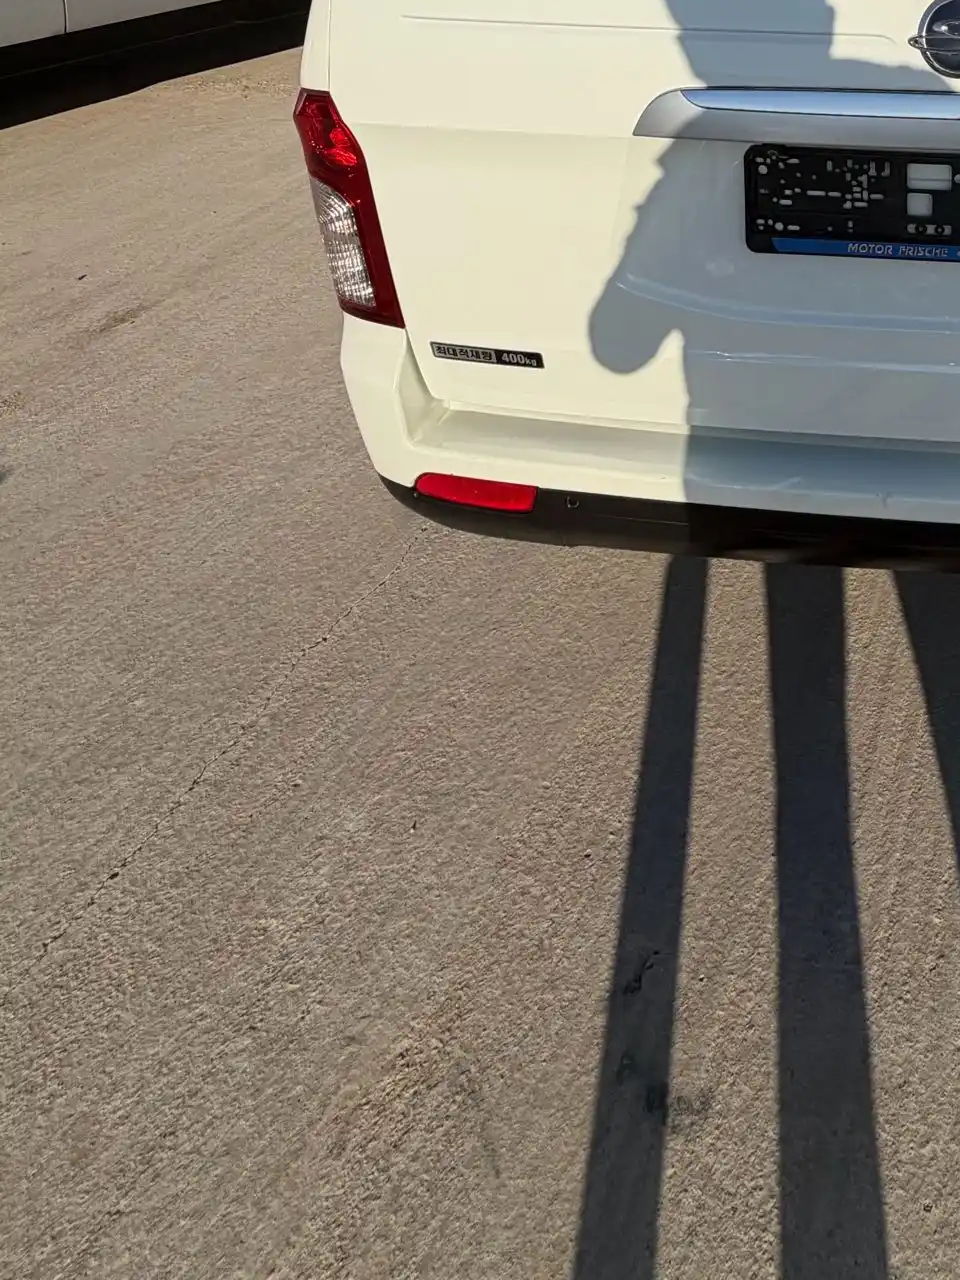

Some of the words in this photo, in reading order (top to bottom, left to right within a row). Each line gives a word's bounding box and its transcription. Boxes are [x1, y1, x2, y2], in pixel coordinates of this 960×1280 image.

[848, 243, 893, 256] MOTOR
[900, 245, 949, 258] FRISCHE
[501, 352, 537, 367] 400kg
